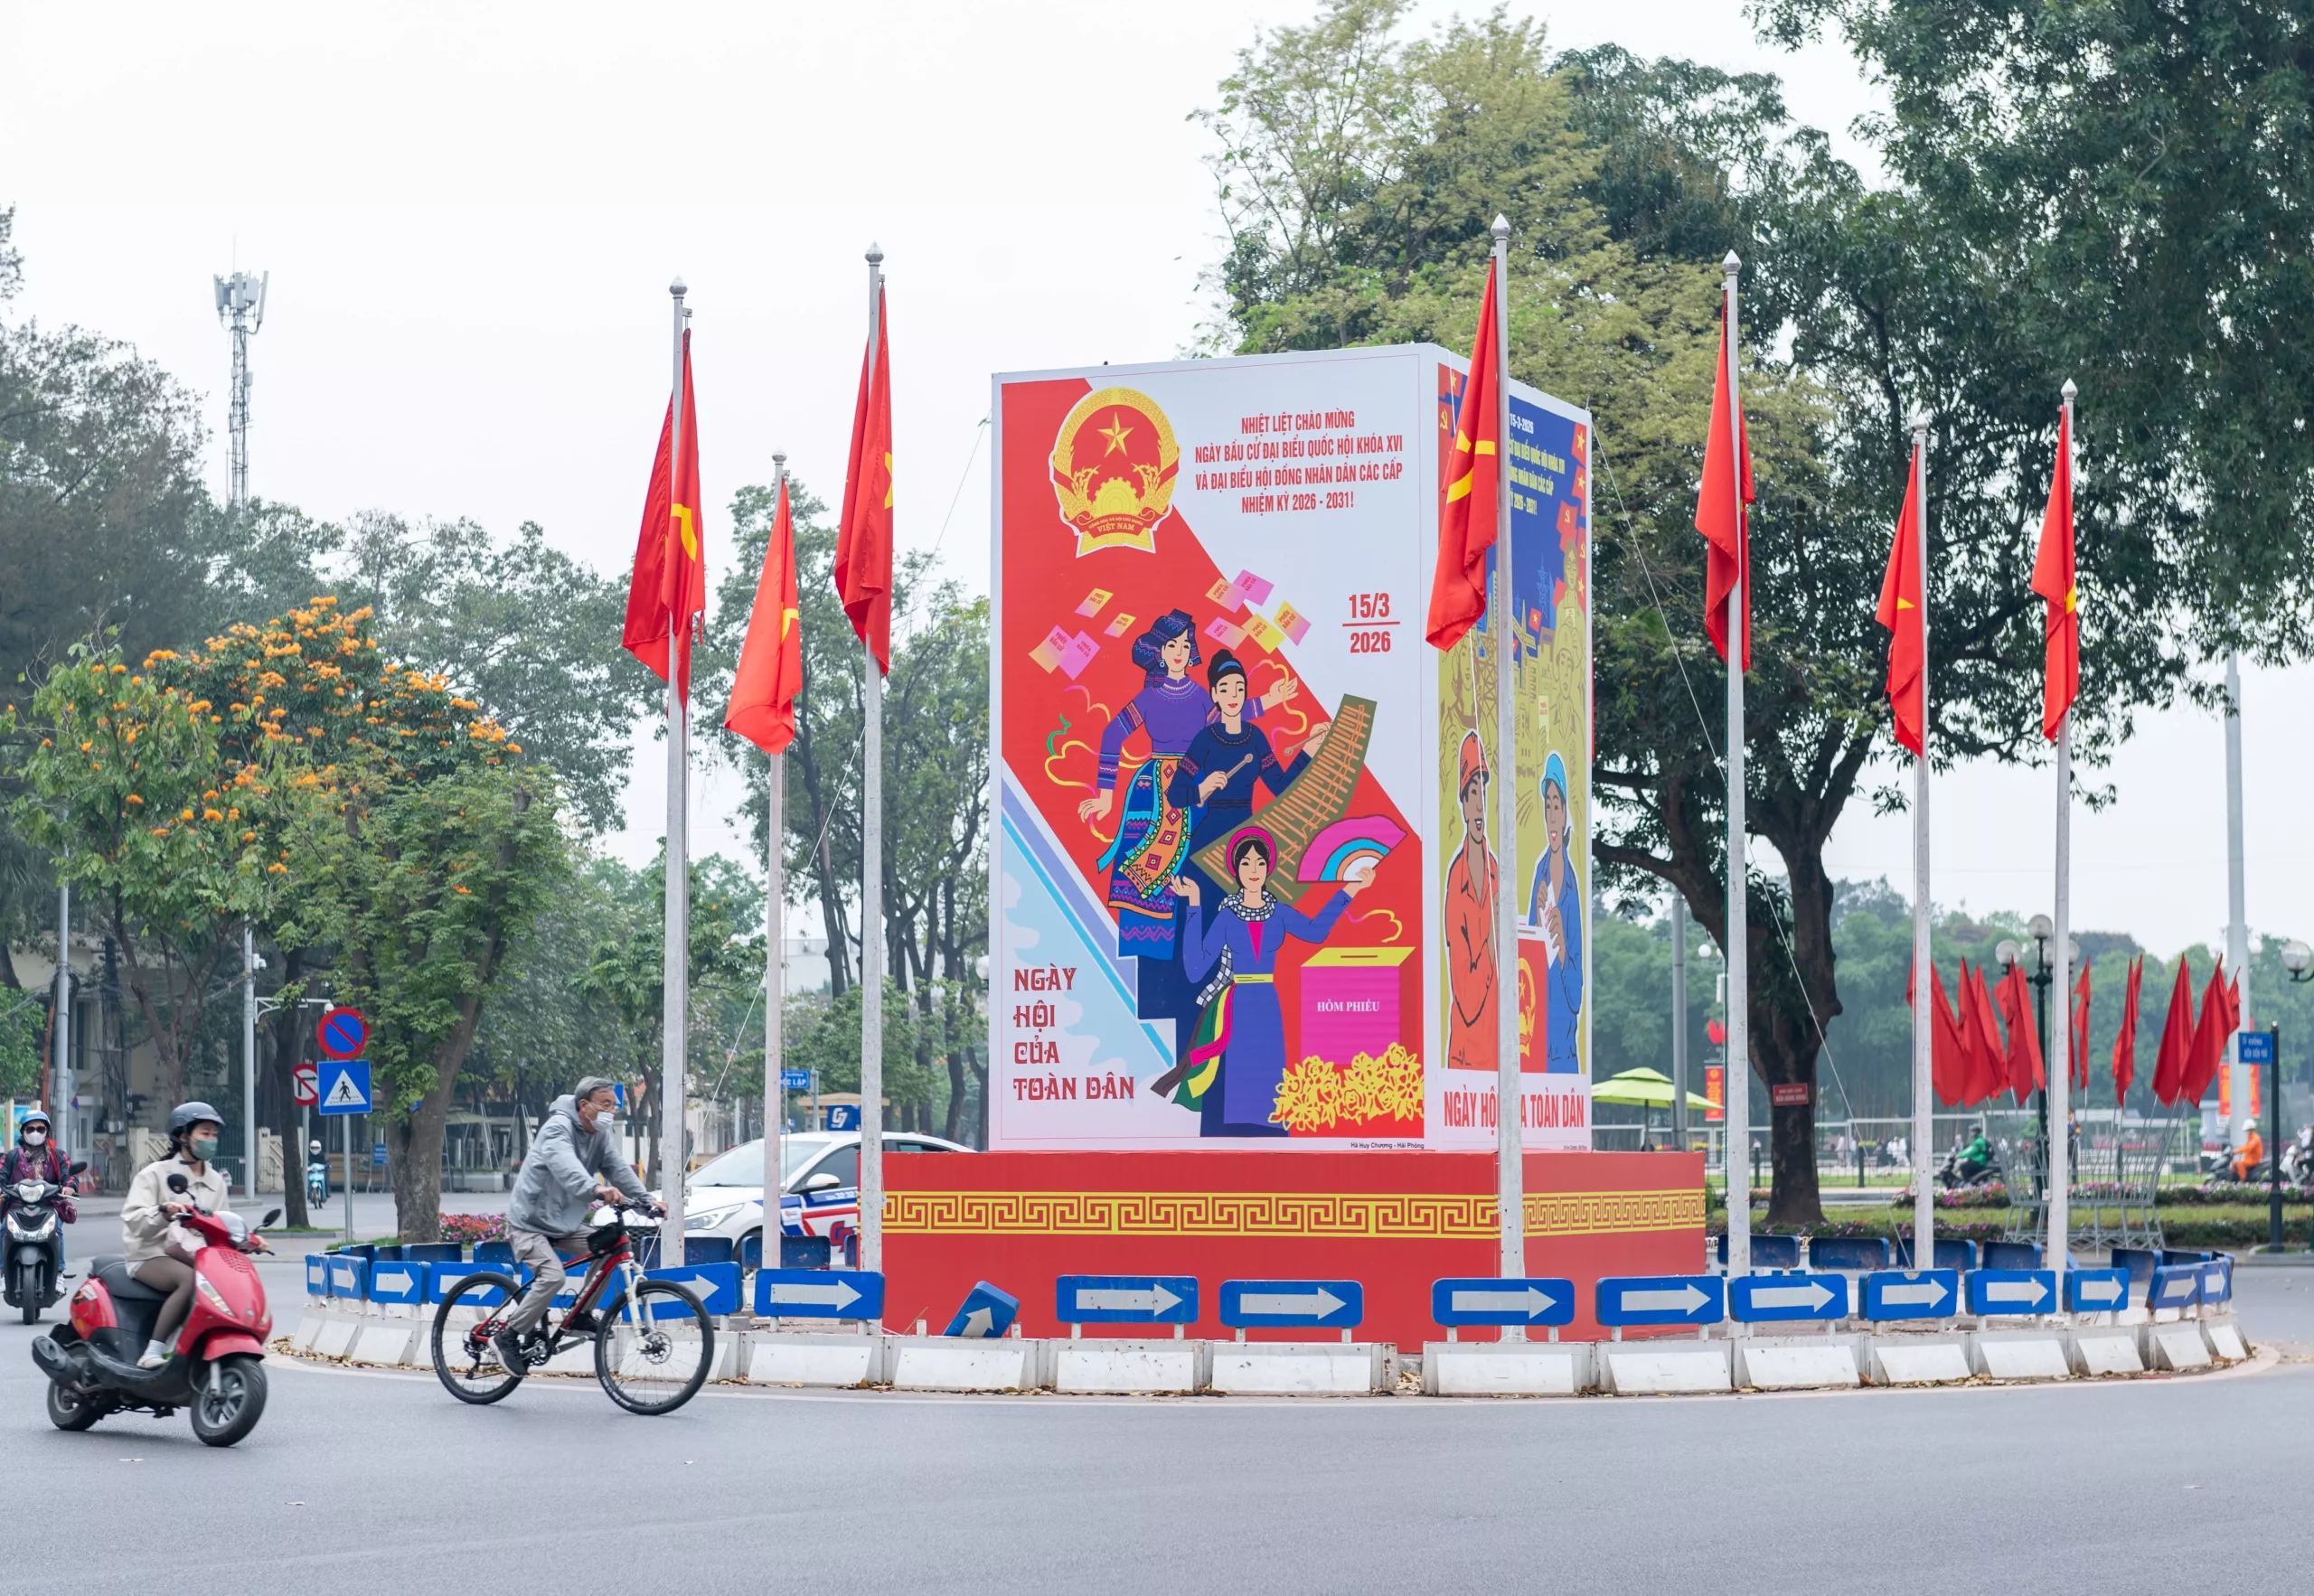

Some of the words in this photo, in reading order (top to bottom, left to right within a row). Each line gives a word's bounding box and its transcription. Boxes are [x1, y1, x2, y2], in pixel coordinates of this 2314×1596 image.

[1242, 413, 1269, 436] NHIỆT
[1273, 411, 1292, 435] LIỆT
[1296, 410, 1321, 431] CHÀO
[1325, 407, 1354, 429] MỪNG
[1195, 442, 1221, 463] NGÀY
[1224, 438, 1243, 461] BẦU
[1247, 436, 1260, 460] CỬ
[1263, 442, 1279, 462] ĐẠI
[1282, 434, 1304, 458] BIỂU
[1308, 433, 1334, 458] QUỐC
[1337, 435, 1354, 458] HỘI
[1357, 433, 1383, 454] KHÓA
[1387, 435, 1403, 452] XVI
[1196, 470, 1208, 490] VÀ
[1211, 472, 1227, 493] ĐẠI
[1230, 464, 1252, 489] BIỂU
[1256, 466, 1271, 490] HỘI
[1275, 463, 1301, 486] ĐỒNG
[1305, 463, 1332, 484] NHÂN
[1336, 463, 1356, 482] DÂN
[1360, 460, 1379, 482] CÁC
[1383, 457, 1403, 480] CẤP
[1242, 492, 1274, 516] NHIỆM
[1277, 491, 1289, 511] KỲ
[1292, 494, 1316, 510] 2026
[1326, 491, 1354, 509] 2031!
[1097, 523, 1115, 532] VIỆT
[1349, 592, 1390, 618] 15/3
[1350, 631, 1391, 653] 2026
[1014, 963, 1077, 991] NGÀY
[1013, 999, 1055, 1033] HỘI
[1317, 998, 1343, 1012] HÒM
[1014, 1035, 1060, 1064] CỦA
[1013, 1072, 1077, 1100] TOÀN
[1086, 1071, 1135, 1099] DÂN
[1444, 1084, 1477, 1127] NGÀY
[1530, 1087, 1559, 1128] TOÀN
[1563, 1088, 1584, 1127] DÂN
